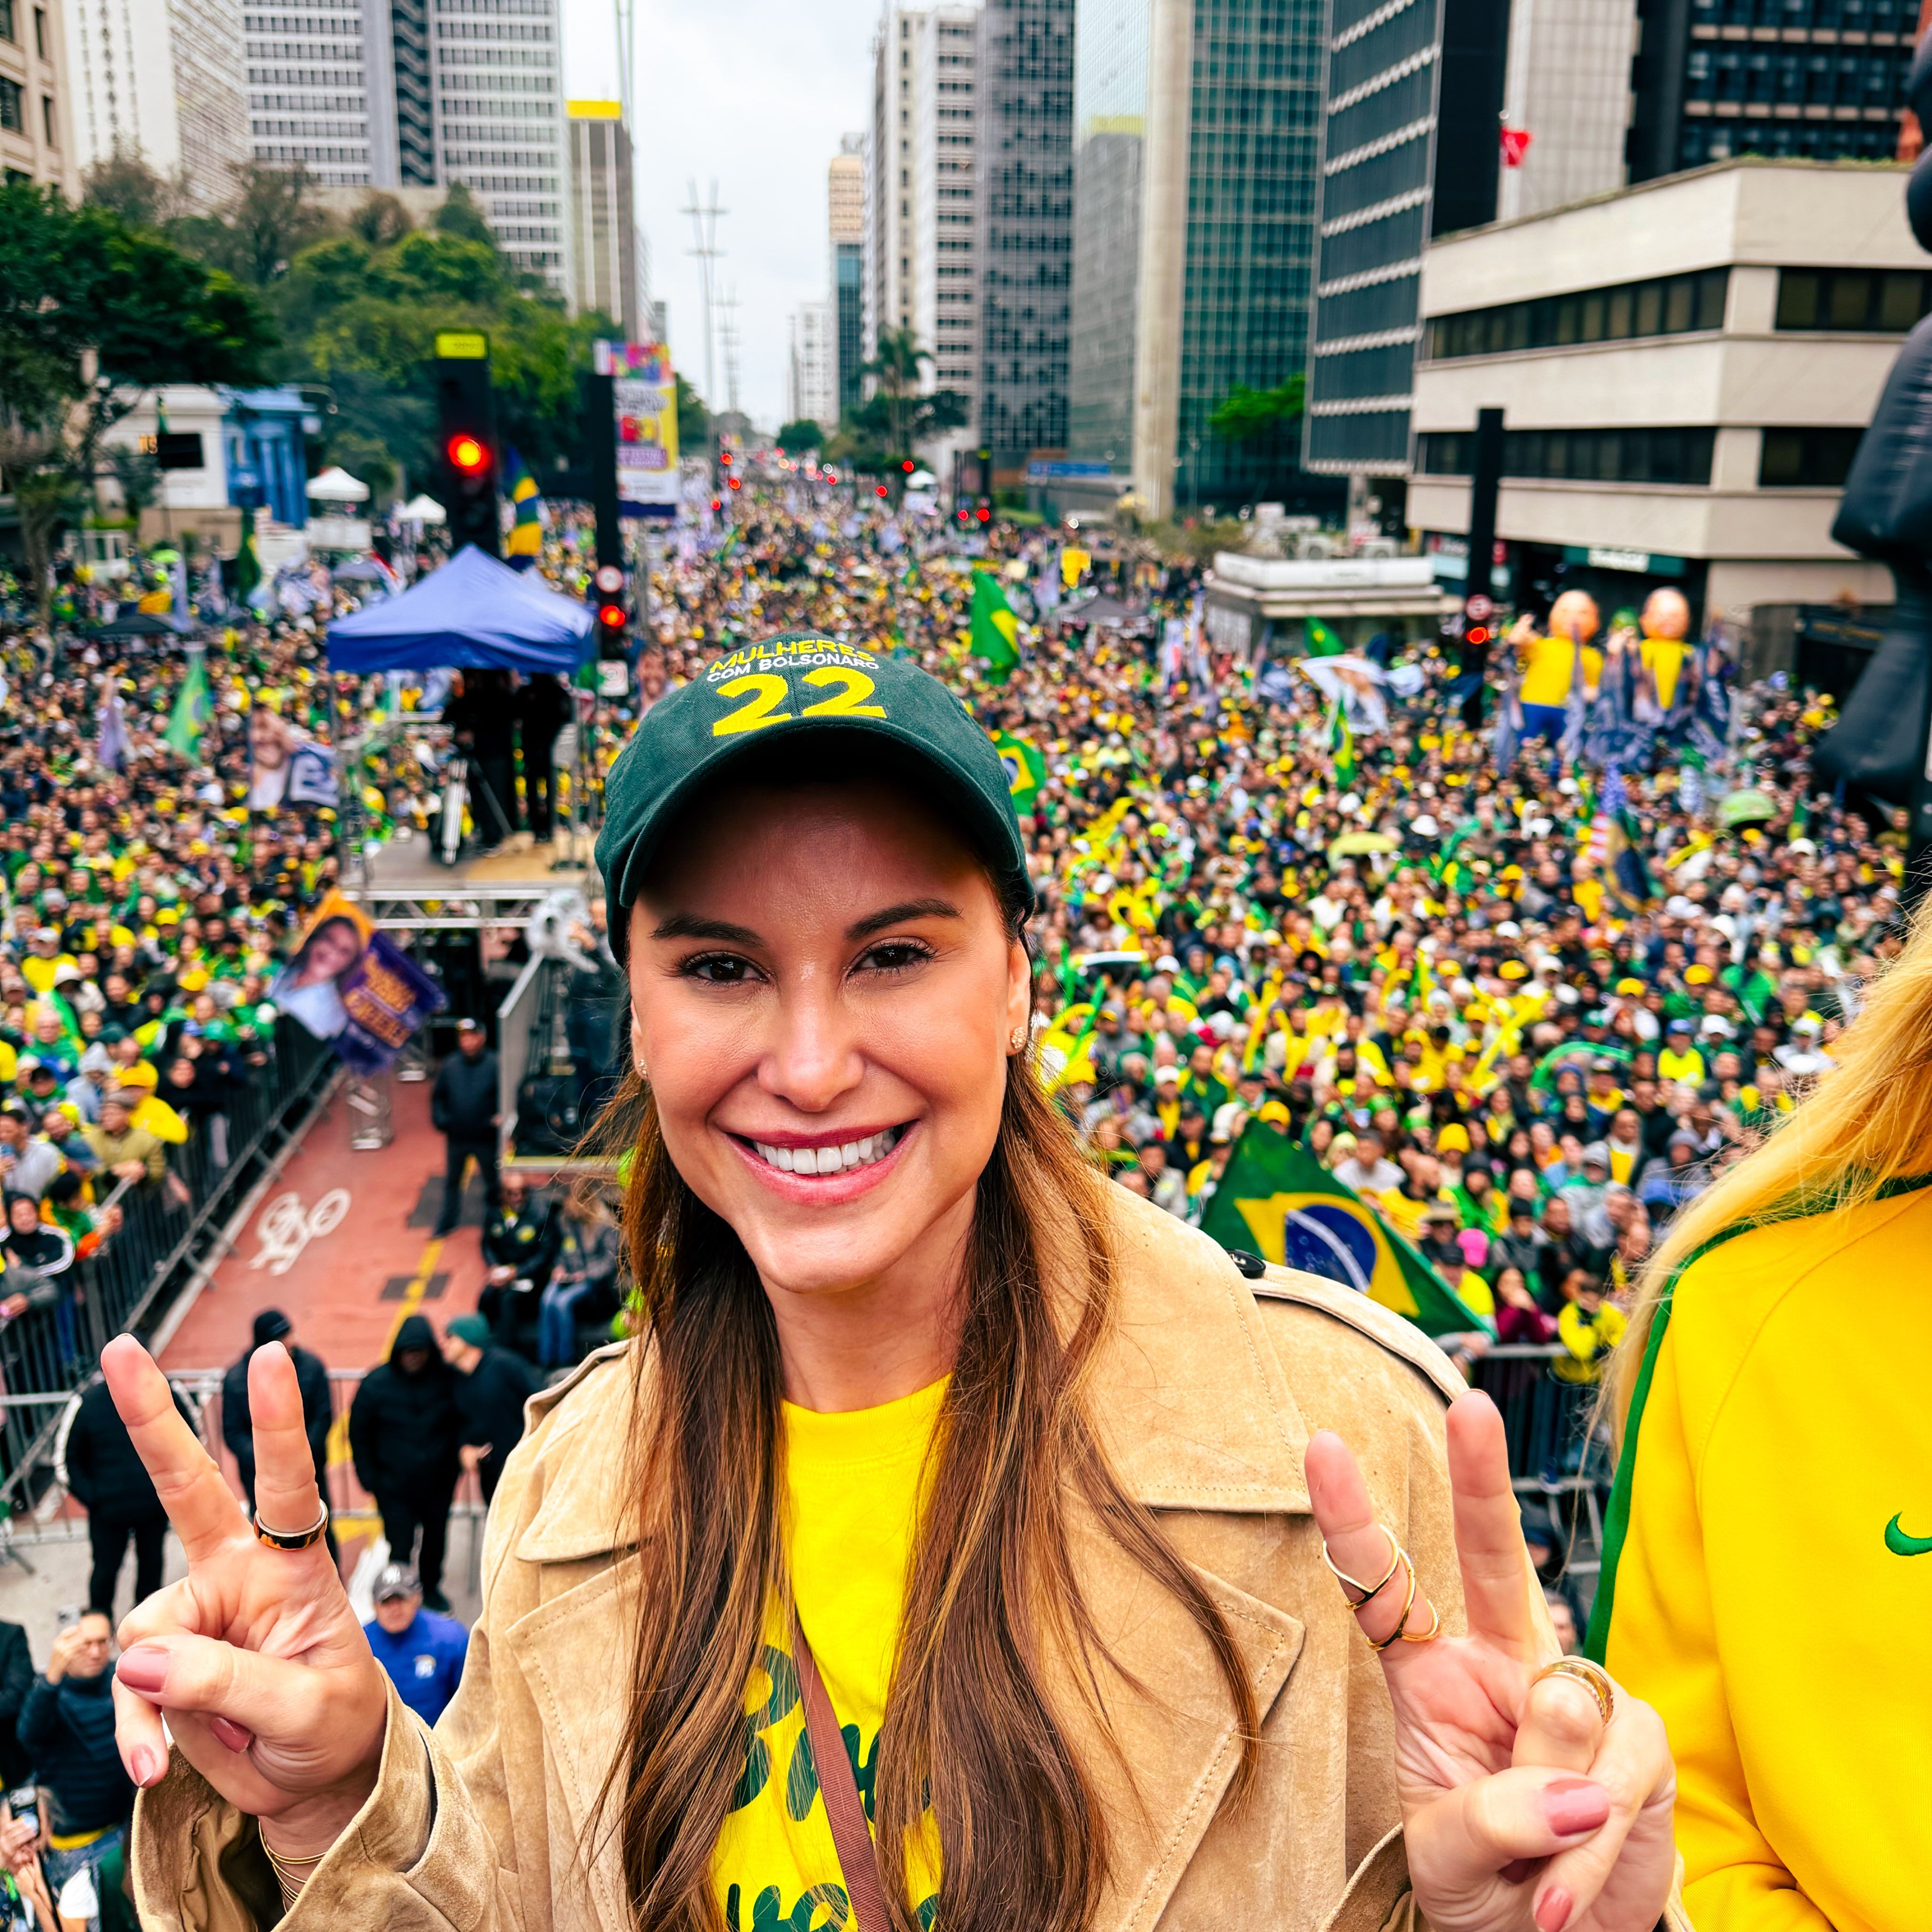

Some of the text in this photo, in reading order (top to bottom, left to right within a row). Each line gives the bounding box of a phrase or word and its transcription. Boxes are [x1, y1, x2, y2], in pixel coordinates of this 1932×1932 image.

[707, 653, 880, 682] COM BOLSONARO
[709, 639, 875, 674] MULHERES
[713, 666, 887, 736] 22
